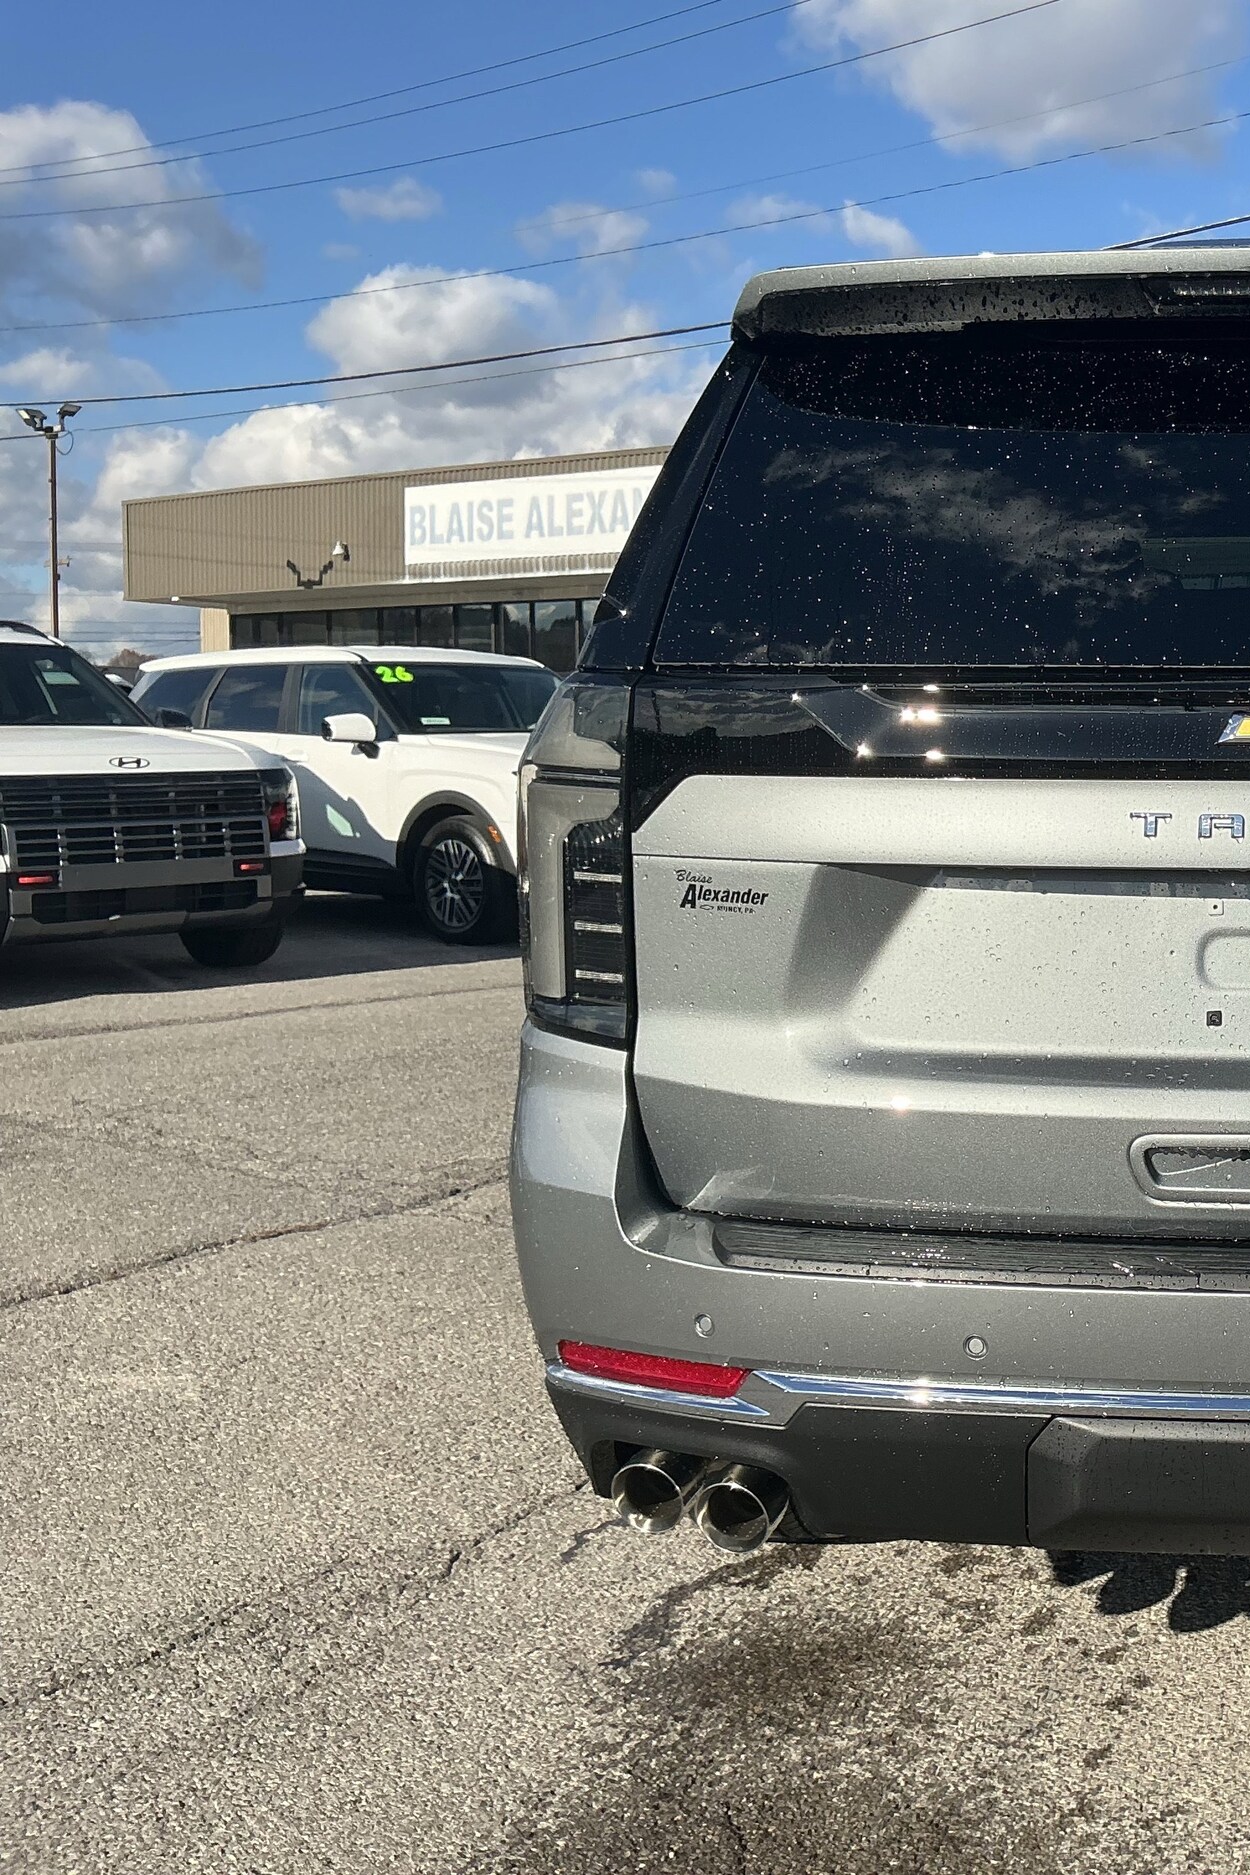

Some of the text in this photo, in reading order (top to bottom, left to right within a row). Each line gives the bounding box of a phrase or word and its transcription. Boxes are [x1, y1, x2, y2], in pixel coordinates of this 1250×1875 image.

[409, 497, 515, 546] BLAISE
[375, 665, 414, 683] 26
[674, 869, 713, 884] Blaise
[680, 883, 769, 909] Alexander
